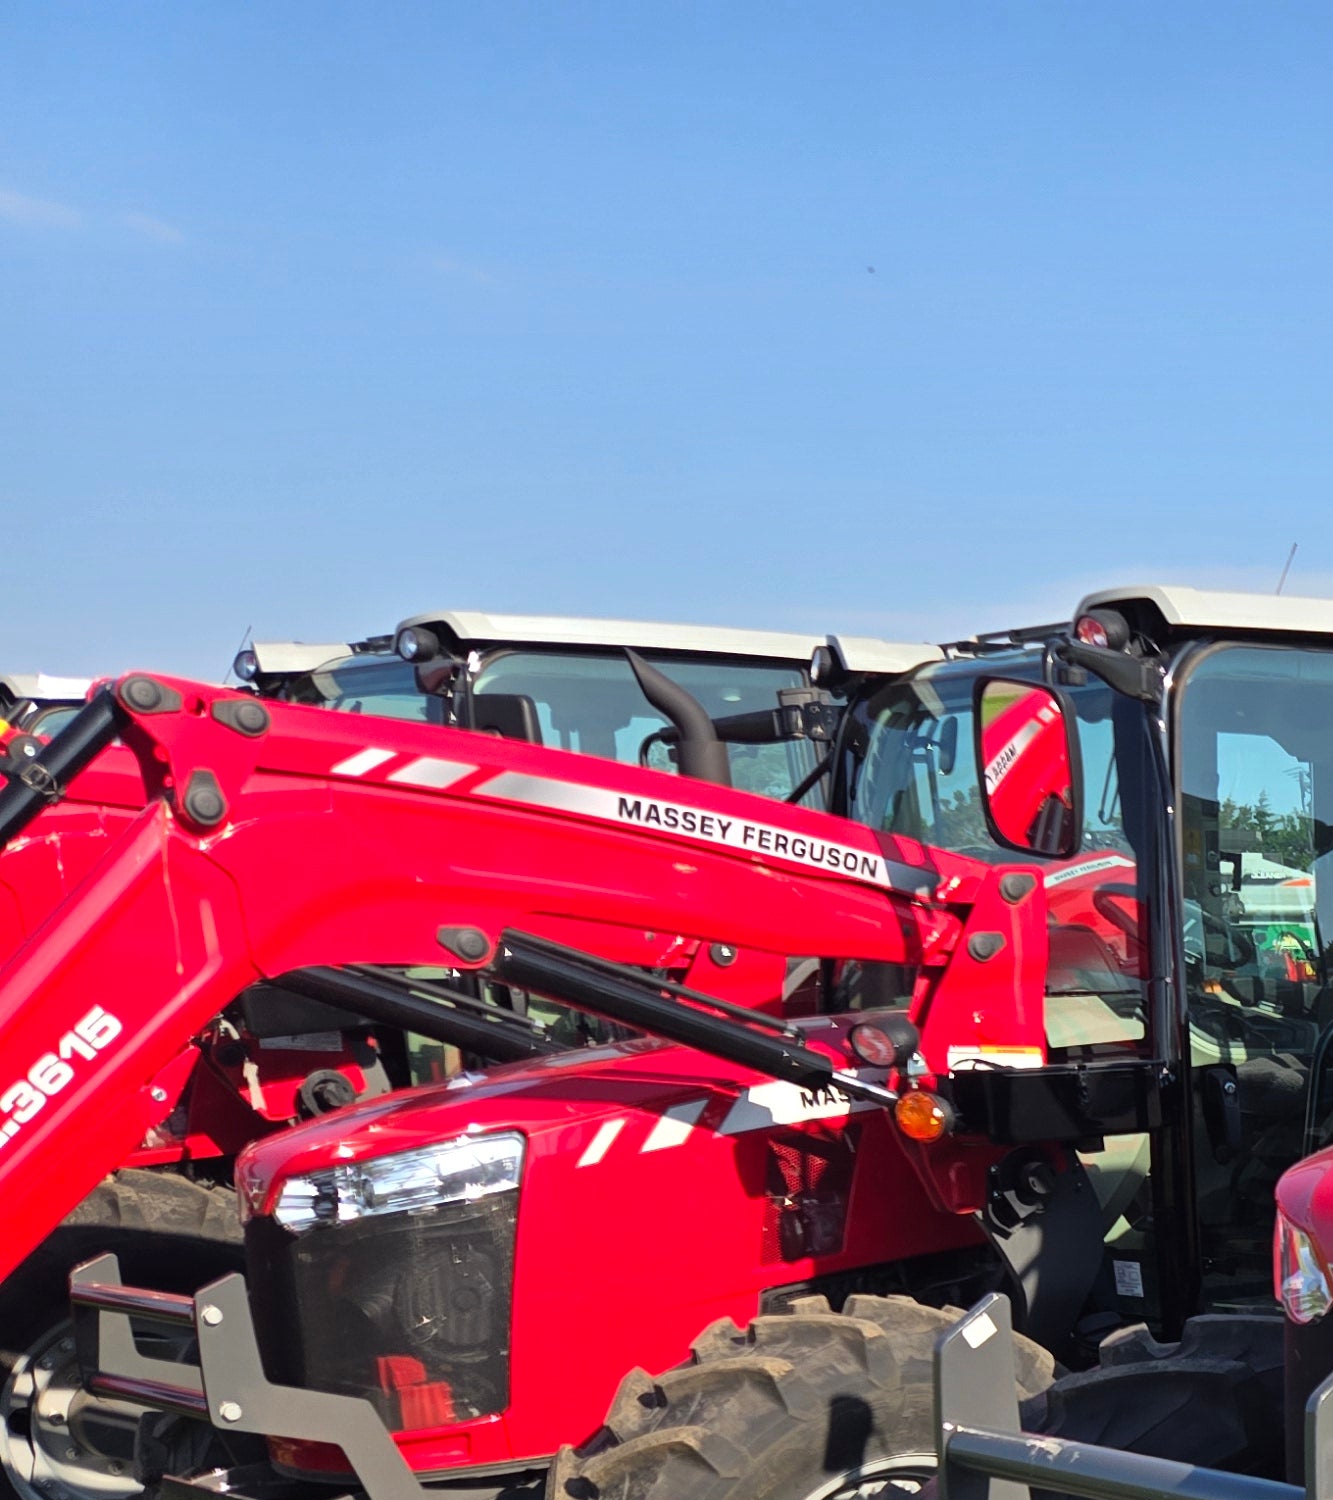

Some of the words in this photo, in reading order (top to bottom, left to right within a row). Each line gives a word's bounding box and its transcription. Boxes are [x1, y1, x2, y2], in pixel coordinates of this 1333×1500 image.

[617, 796, 732, 840] MASSEY
[742, 825, 879, 879] FERGUSON
[0, 1003, 123, 1149] .3615
